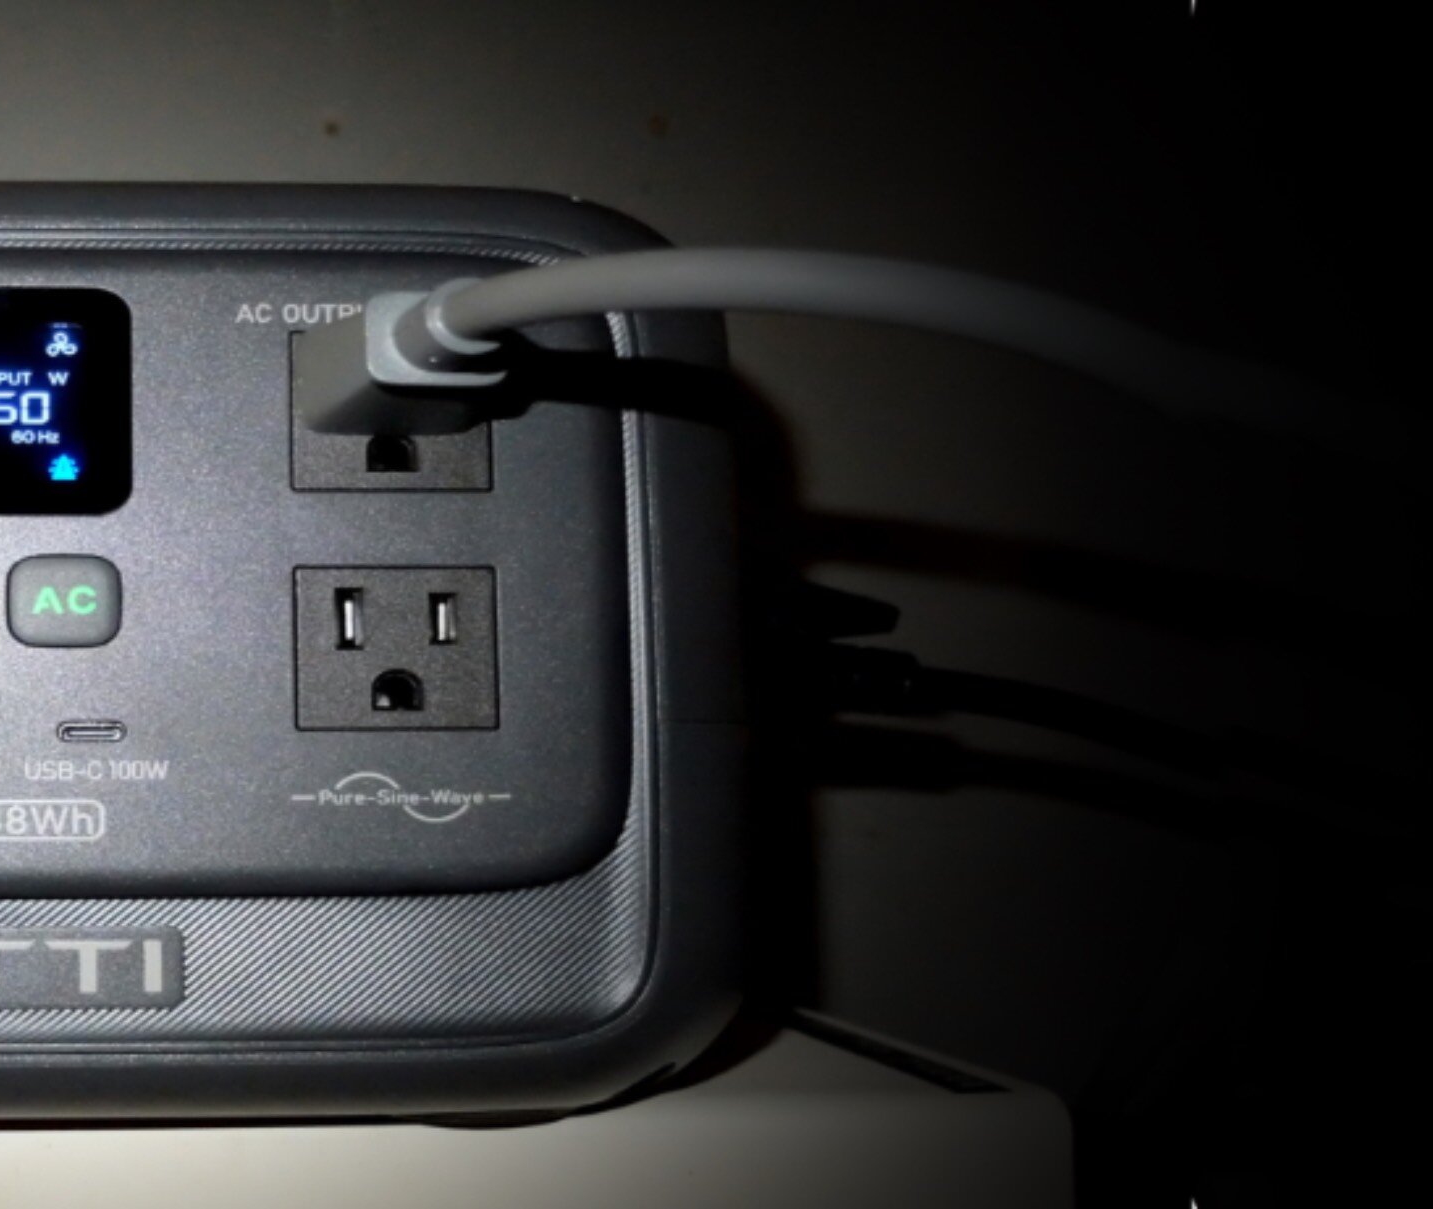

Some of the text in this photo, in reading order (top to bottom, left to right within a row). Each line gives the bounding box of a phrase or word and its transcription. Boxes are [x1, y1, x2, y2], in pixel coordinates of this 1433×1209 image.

[234, 303, 363, 324] AC OUTP
[48, 371, 69, 386] W
[10, 429, 60, 444] 60 Hz
[32, 584, 98, 616] AC
[23, 760, 170, 782] USB-C 100W
